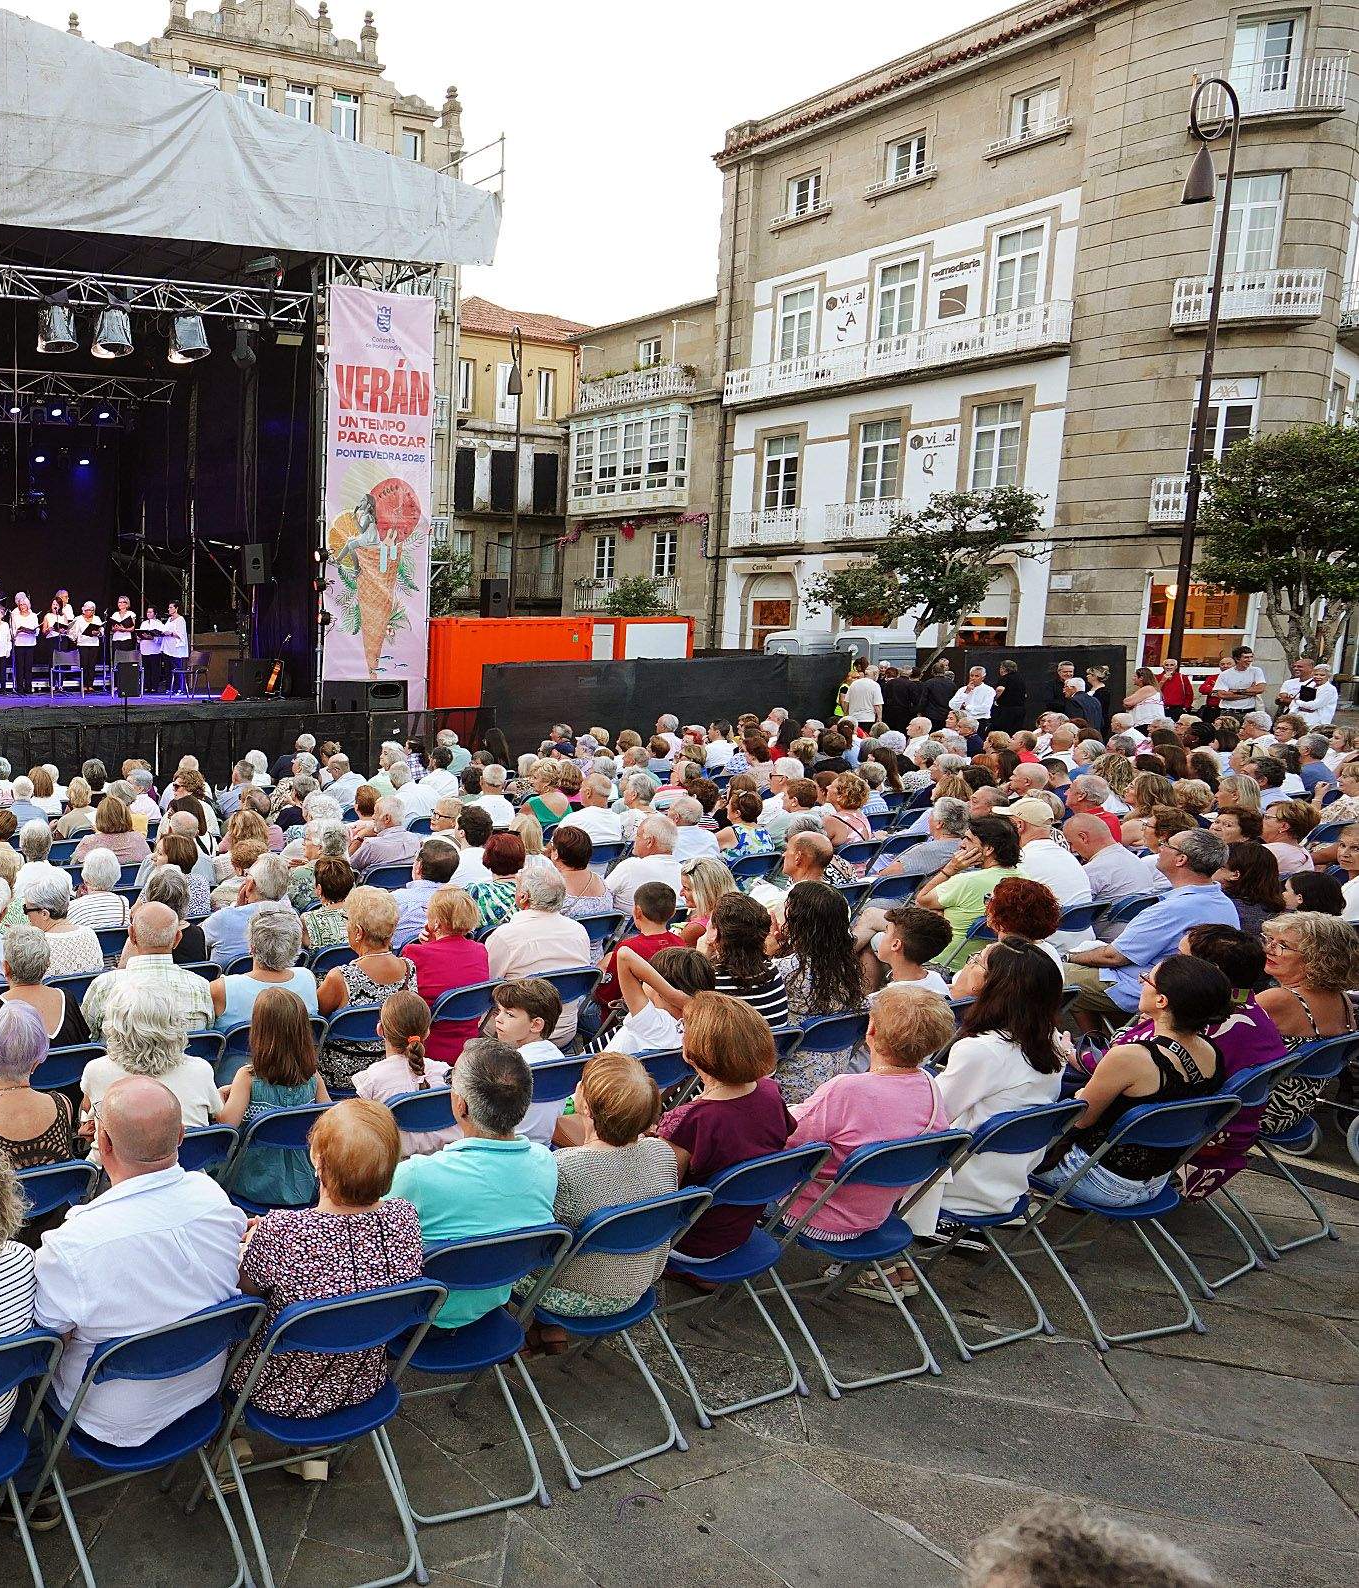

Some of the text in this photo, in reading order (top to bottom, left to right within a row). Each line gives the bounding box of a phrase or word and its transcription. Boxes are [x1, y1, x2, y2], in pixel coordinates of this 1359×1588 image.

[335, 358, 430, 416] VERÁN
[1209, 379, 1240, 398] AXA
[338, 415, 406, 433] UN TEMPO
[337, 430, 426, 449] PARA GOZAR
[335, 448, 426, 463] PONTEVEDRA 2025
